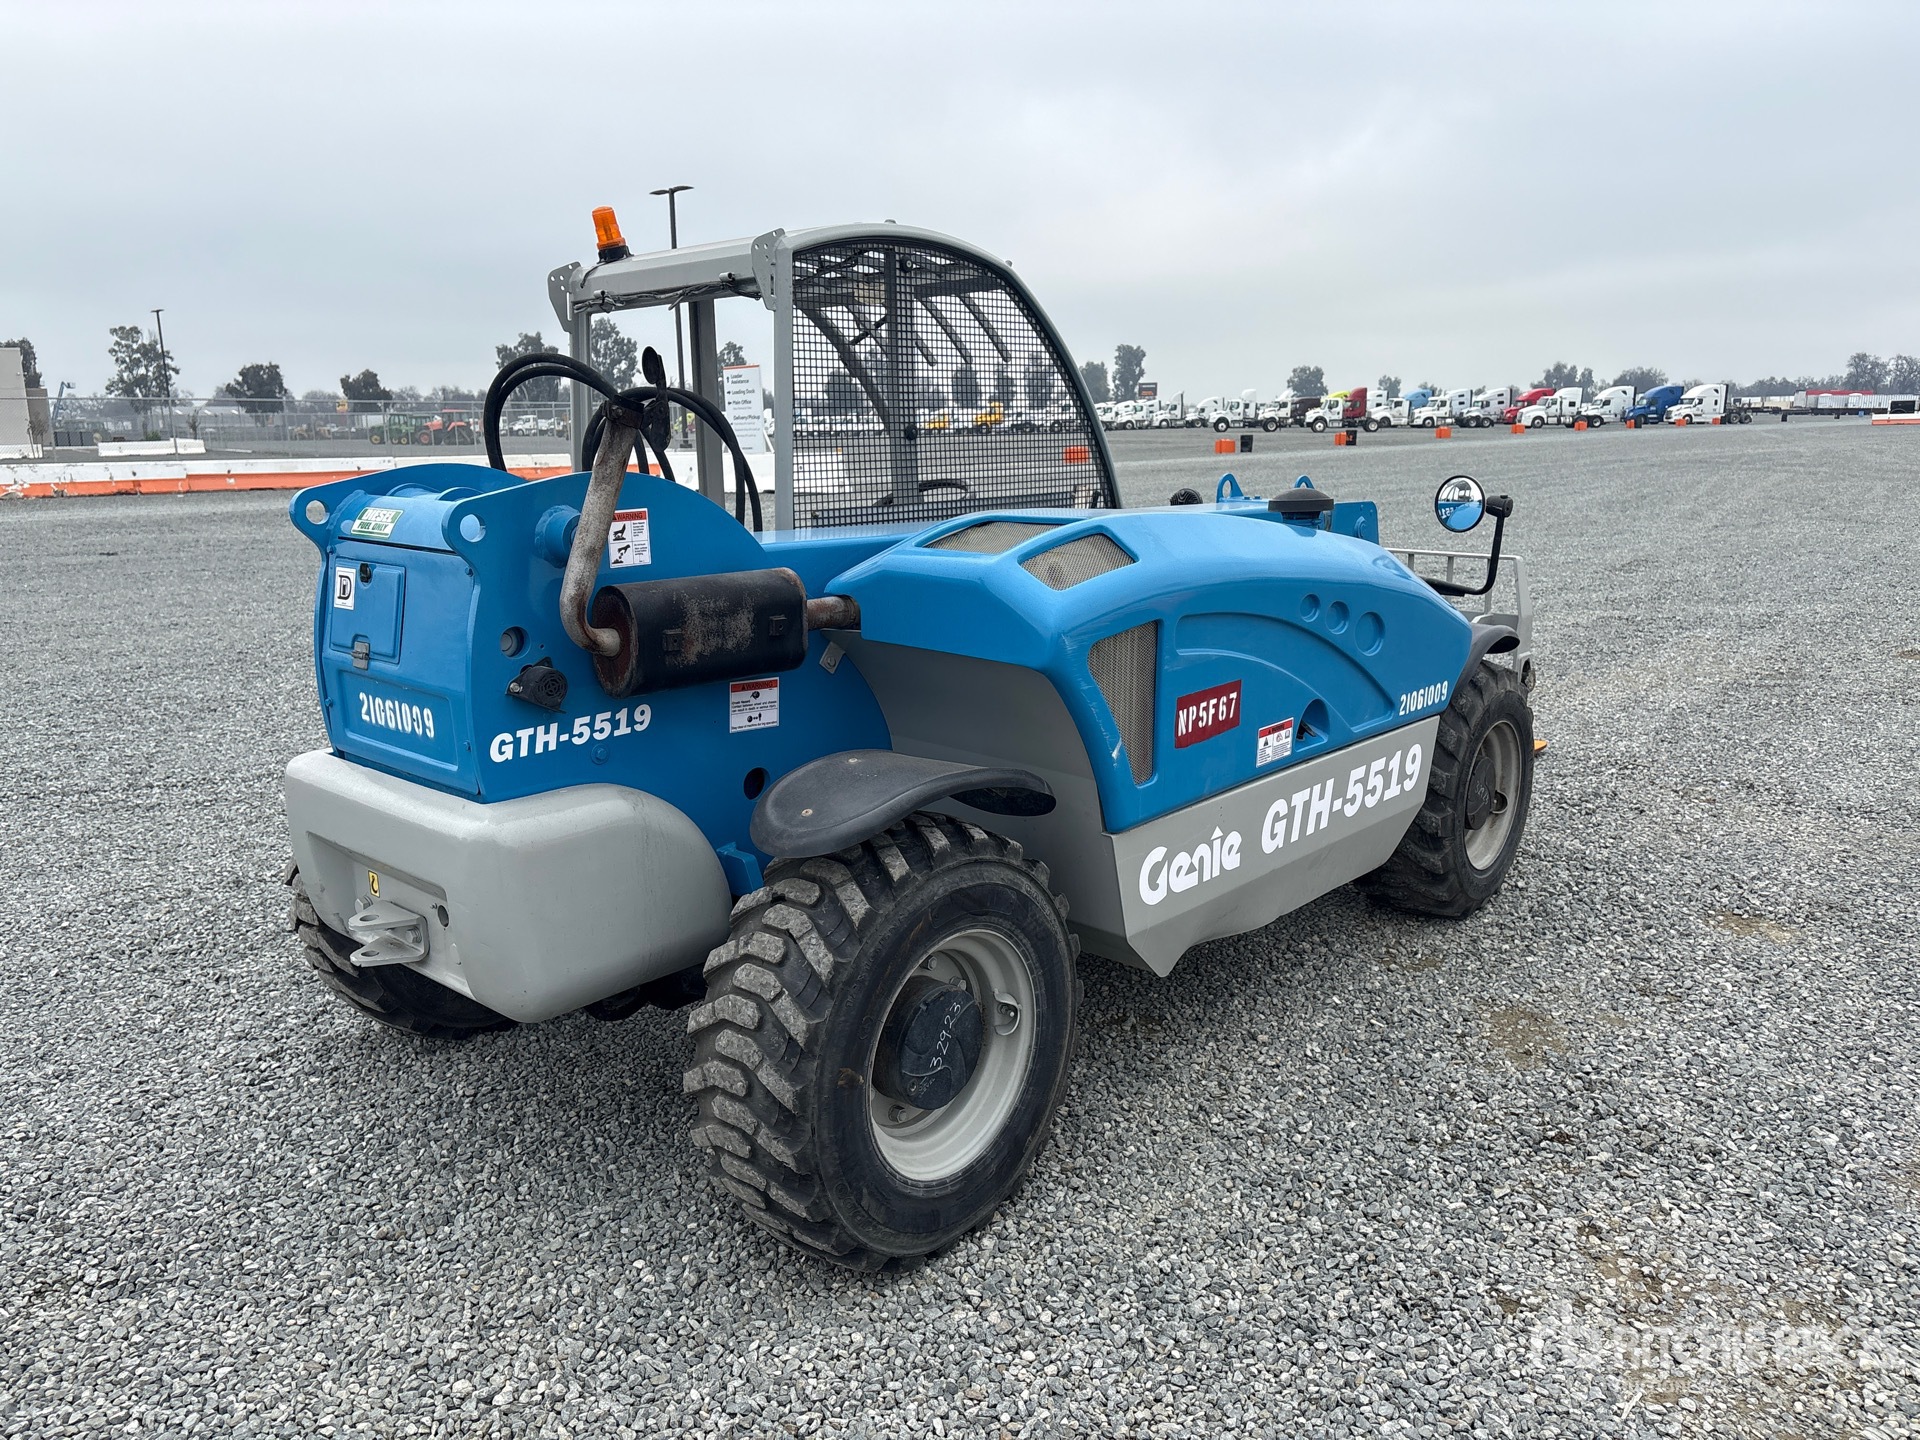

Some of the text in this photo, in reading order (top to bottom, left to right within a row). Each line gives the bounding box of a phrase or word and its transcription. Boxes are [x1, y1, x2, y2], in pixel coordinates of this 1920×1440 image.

[357, 521, 389, 531] FUEL ONLY
[362, 507, 396, 522] DIESEL
[616, 512, 643, 520] WARNING
[359, 691, 435, 738] 21061009
[1177, 691, 1238, 737] NP5F67
[1399, 680, 1449, 716] 21061009
[489, 704, 652, 763] GTH-5519
[1139, 743, 1422, 906] Genie GTH-5519
